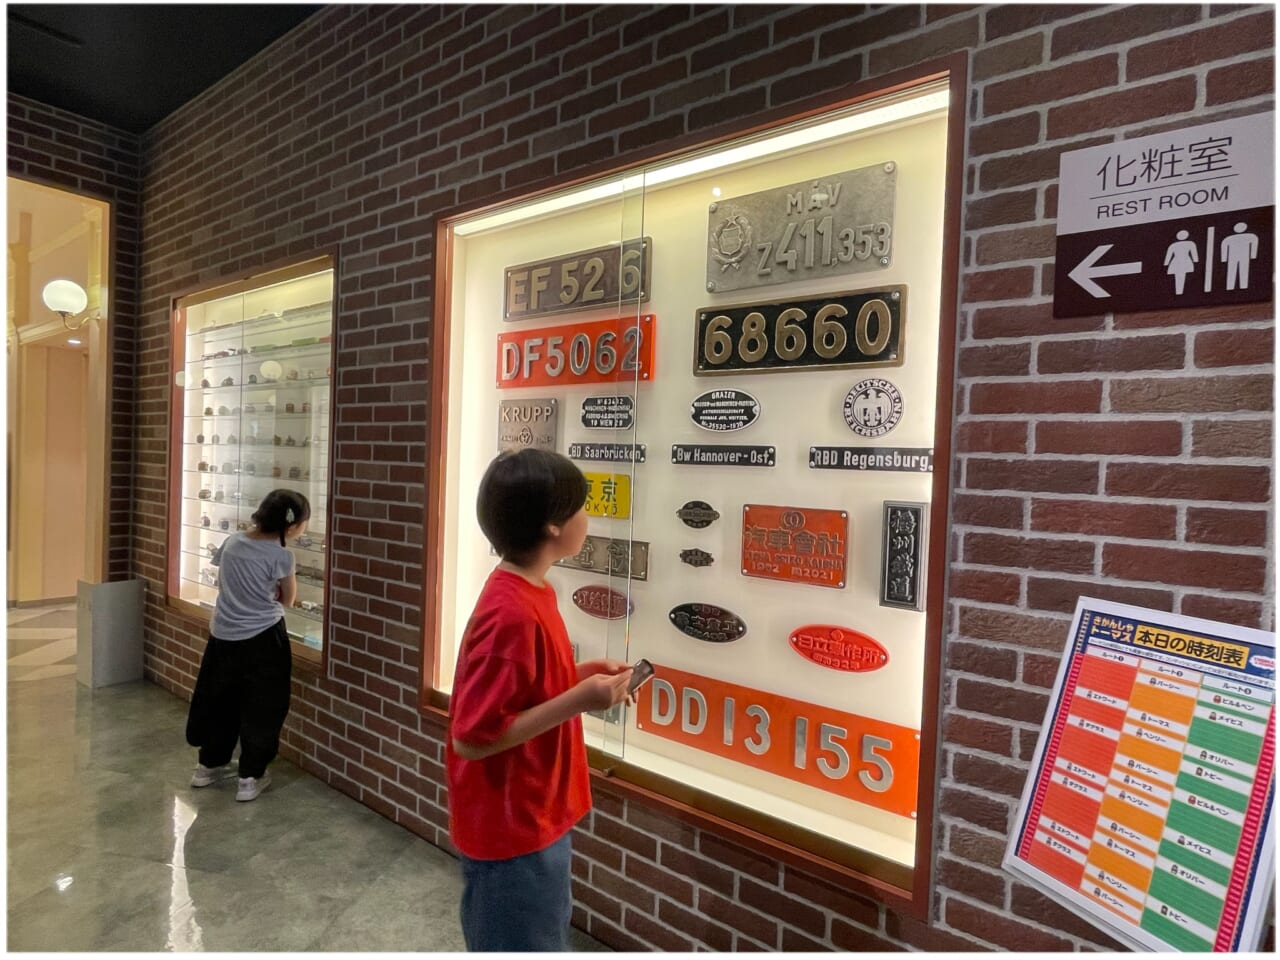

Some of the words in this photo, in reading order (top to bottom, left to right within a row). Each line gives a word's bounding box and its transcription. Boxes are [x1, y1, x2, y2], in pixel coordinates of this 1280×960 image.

[1096, 136, 1233, 191] 化粧室
[1096, 198, 1152, 219] REST
[1158, 185, 1229, 210] ROOM
[509, 267, 552, 313] EF
[704, 299, 892, 365] 68660
[501, 326, 643, 381] DF5062
[711, 391, 736, 400] GRAZER
[501, 406, 553, 423] KRUPP
[585, 446, 641, 460] Saarbrücken
[815, 450, 838, 465] RBD
[843, 450, 930, 472] Regensburg
[1091, 625, 1133, 644] トーマス
[1136, 629, 1246, 667] 本日の時刻表
[651, 678, 708, 735] DD
[723, 696, 771, 756] 13
[794, 716, 895, 793] 155
